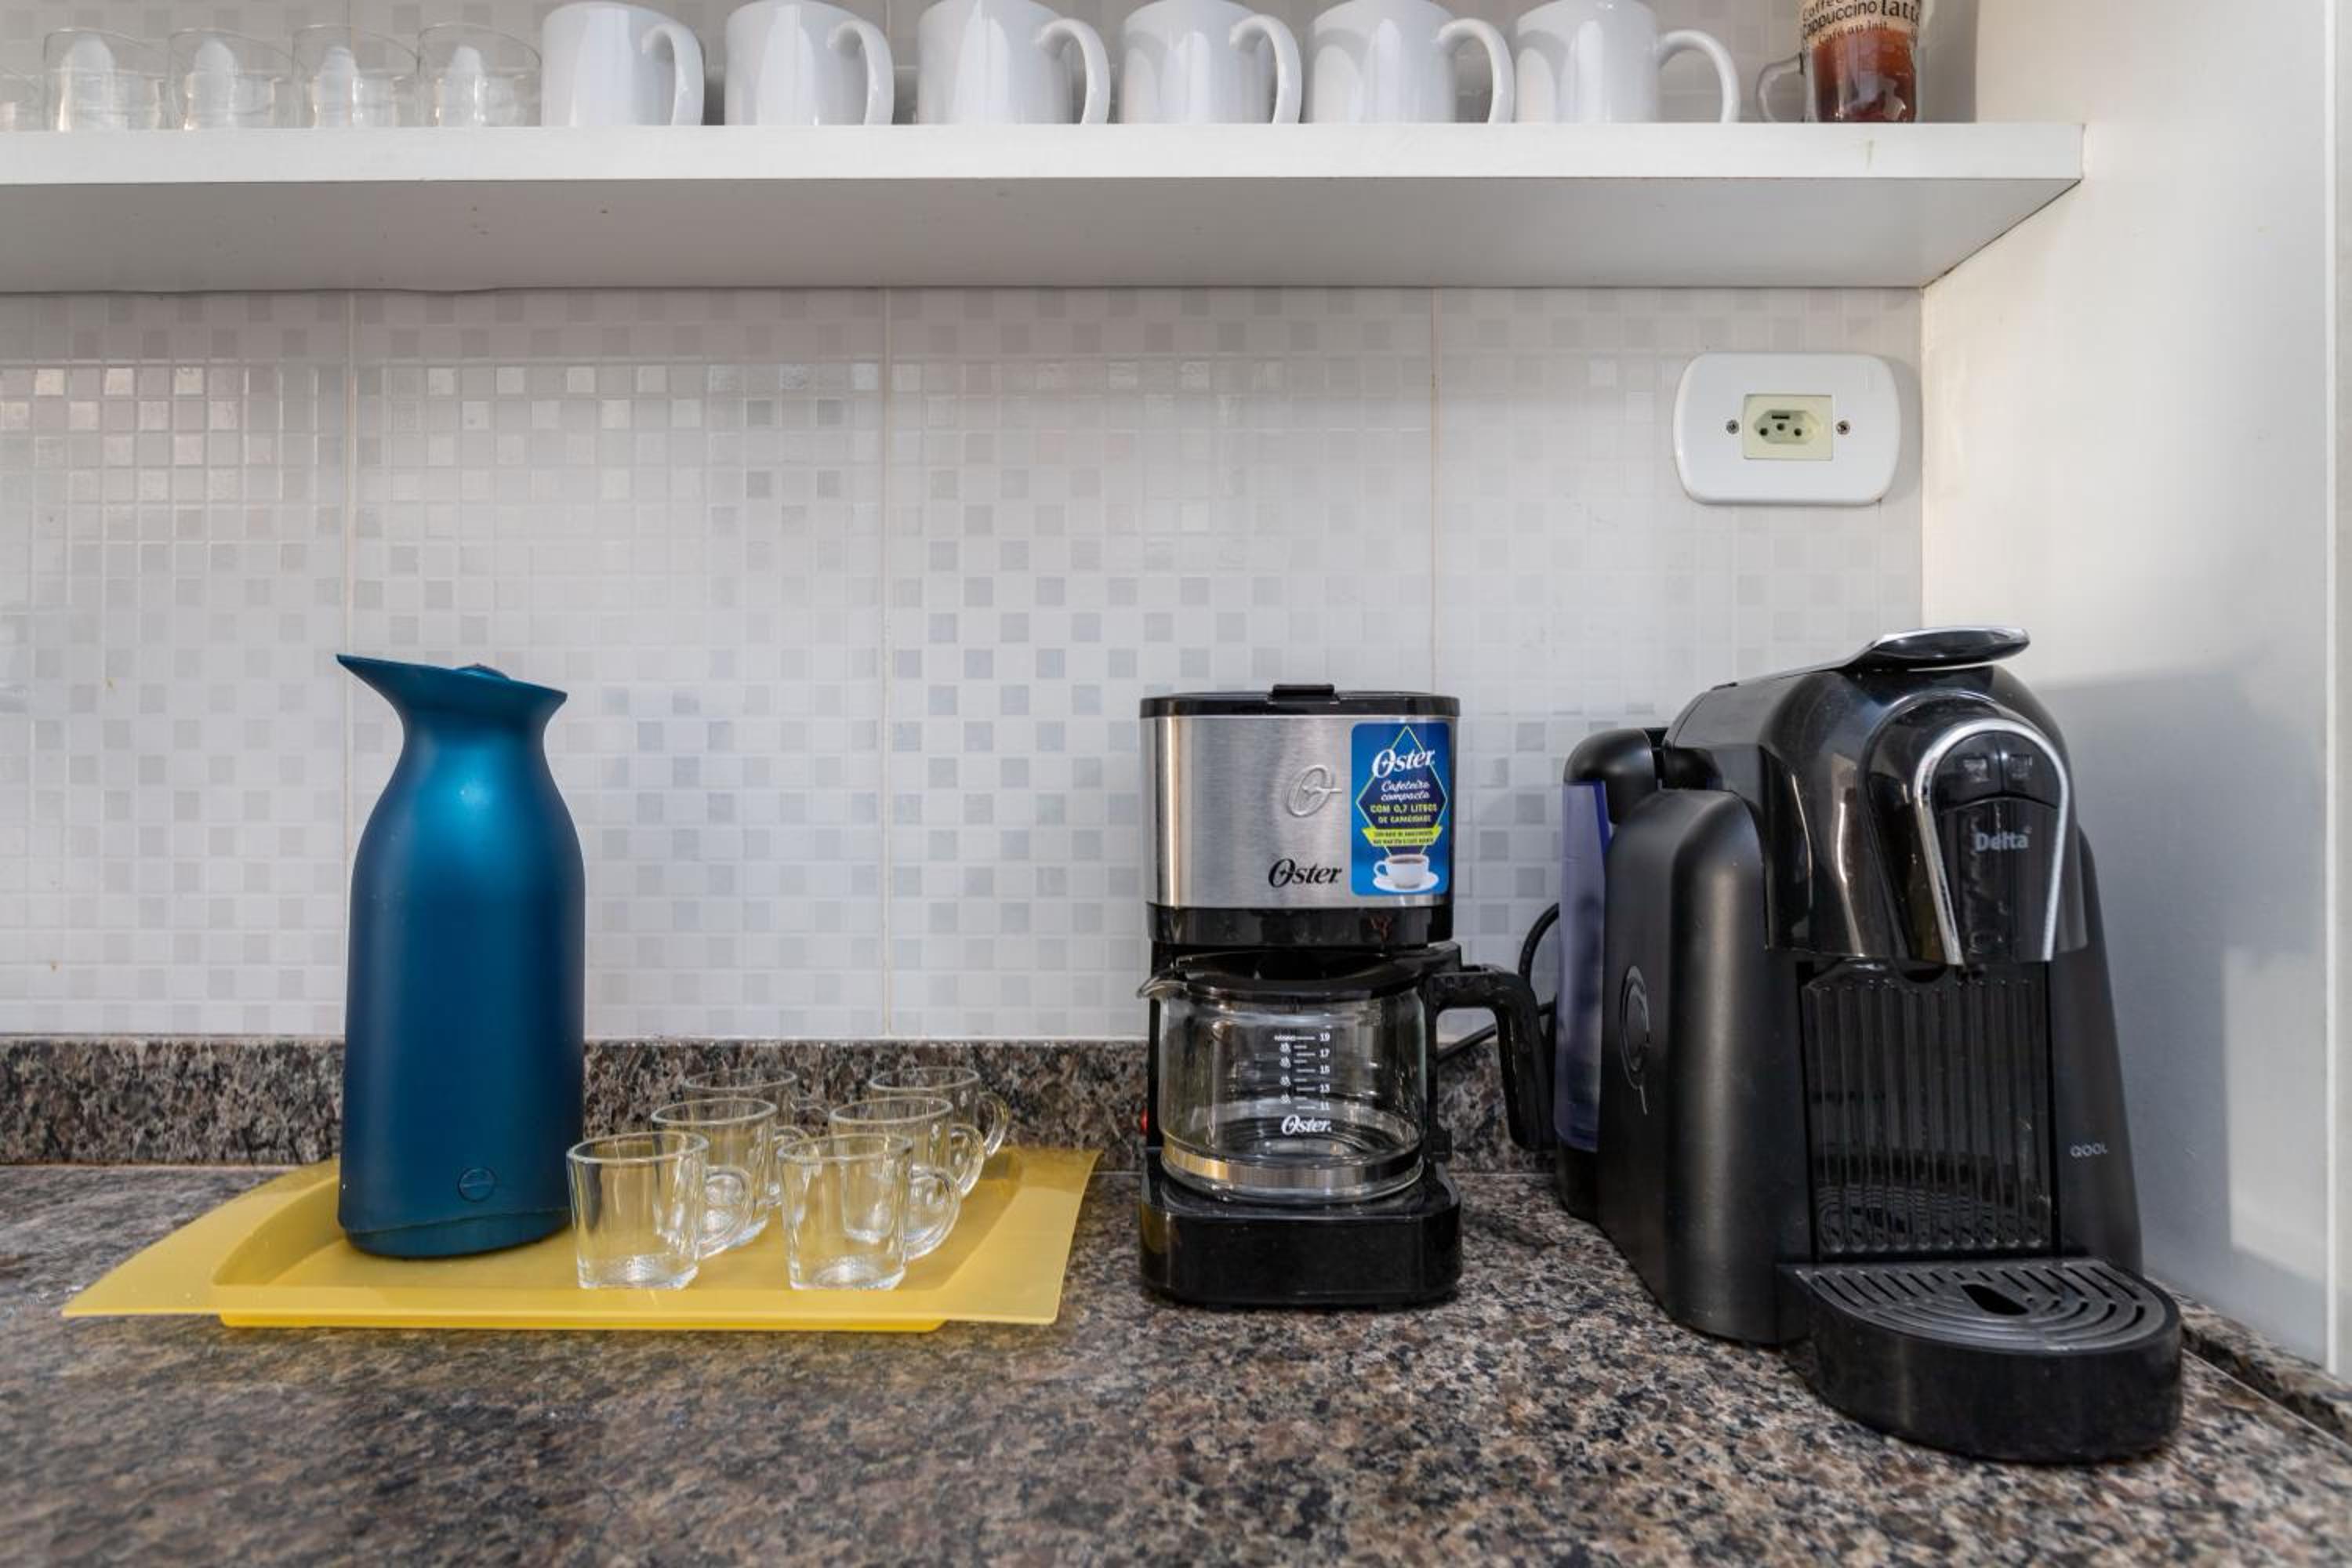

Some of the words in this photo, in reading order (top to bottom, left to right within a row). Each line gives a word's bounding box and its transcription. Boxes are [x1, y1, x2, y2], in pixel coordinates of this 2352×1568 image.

[1372, 749, 1436, 779] Oster
[1370, 804, 1391, 813] COM
[1410, 803, 1438, 812] LITROS
[1975, 831, 2029, 851] Delta
[1268, 858, 1342, 888] Oster
[1280, 1114, 1331, 1135] Oster
[2070, 1143, 2108, 1158] QOOL
